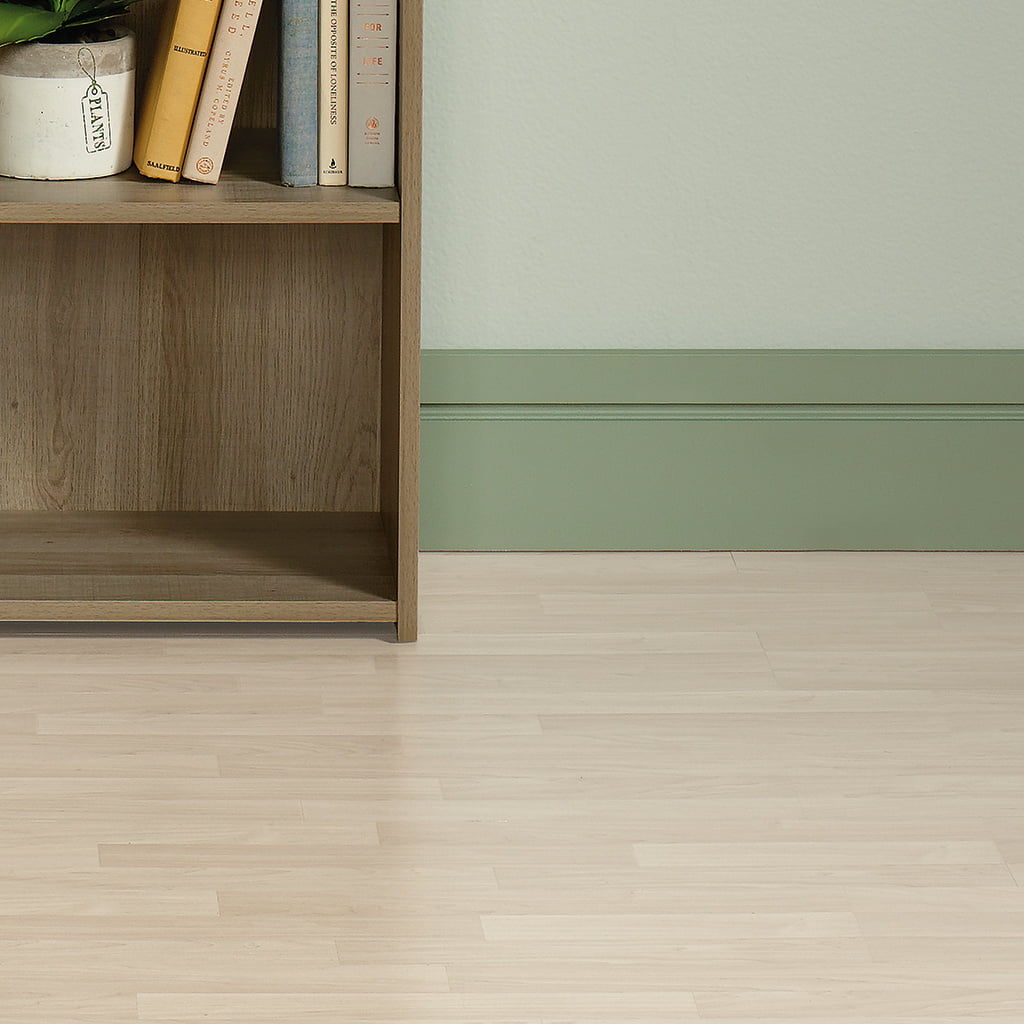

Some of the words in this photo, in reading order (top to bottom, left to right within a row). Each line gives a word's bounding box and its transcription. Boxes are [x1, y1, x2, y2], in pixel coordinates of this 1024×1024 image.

[363, 23, 382, 31] FOR
[330, 60, 337, 72] OF
[362, 57, 383, 66] LIFE
[221, 77, 235, 111] EDITED
[89, 97, 106, 150] PLANTS
[202, 98, 220, 147] COPELAND
[146, 160, 181, 173] SAALFIELD
